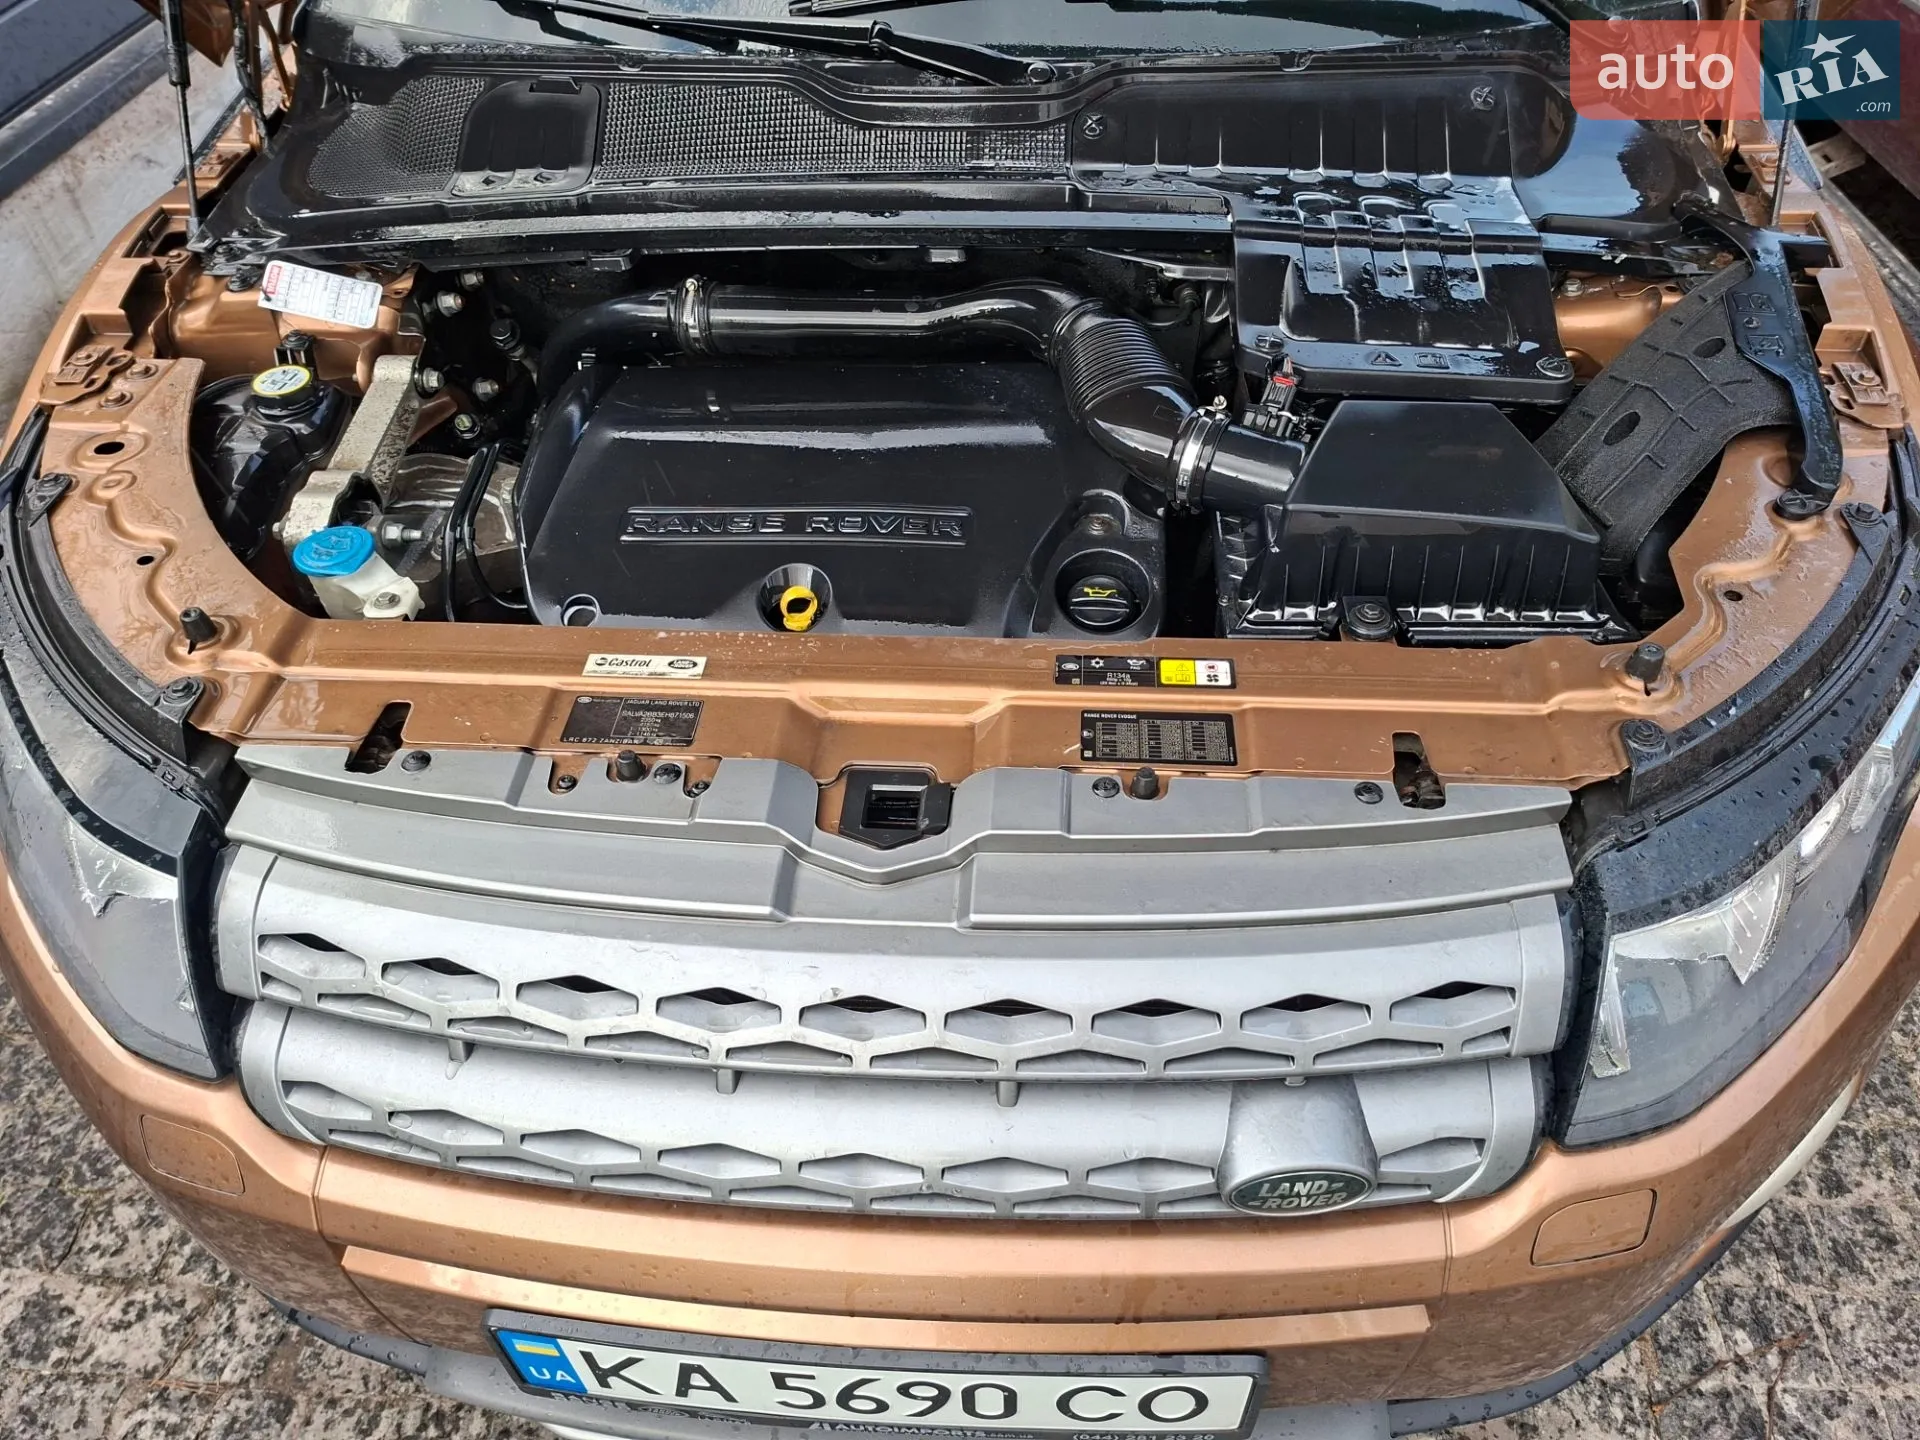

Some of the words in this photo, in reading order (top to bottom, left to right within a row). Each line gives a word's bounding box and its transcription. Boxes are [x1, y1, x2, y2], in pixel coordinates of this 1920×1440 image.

[625, 514, 787, 533] RANGE
[805, 514, 963, 537] ROVER
[608, 657, 652, 668] Castrol
[1258, 1180, 1329, 1196] LAND
[1262, 1192, 1348, 1209] ROVER
[529, 1366, 576, 1384] UA
[579, 1350, 738, 1403] KA
[770, 1371, 1018, 1420] 5690
[1055, 1384, 1210, 1424] CO
